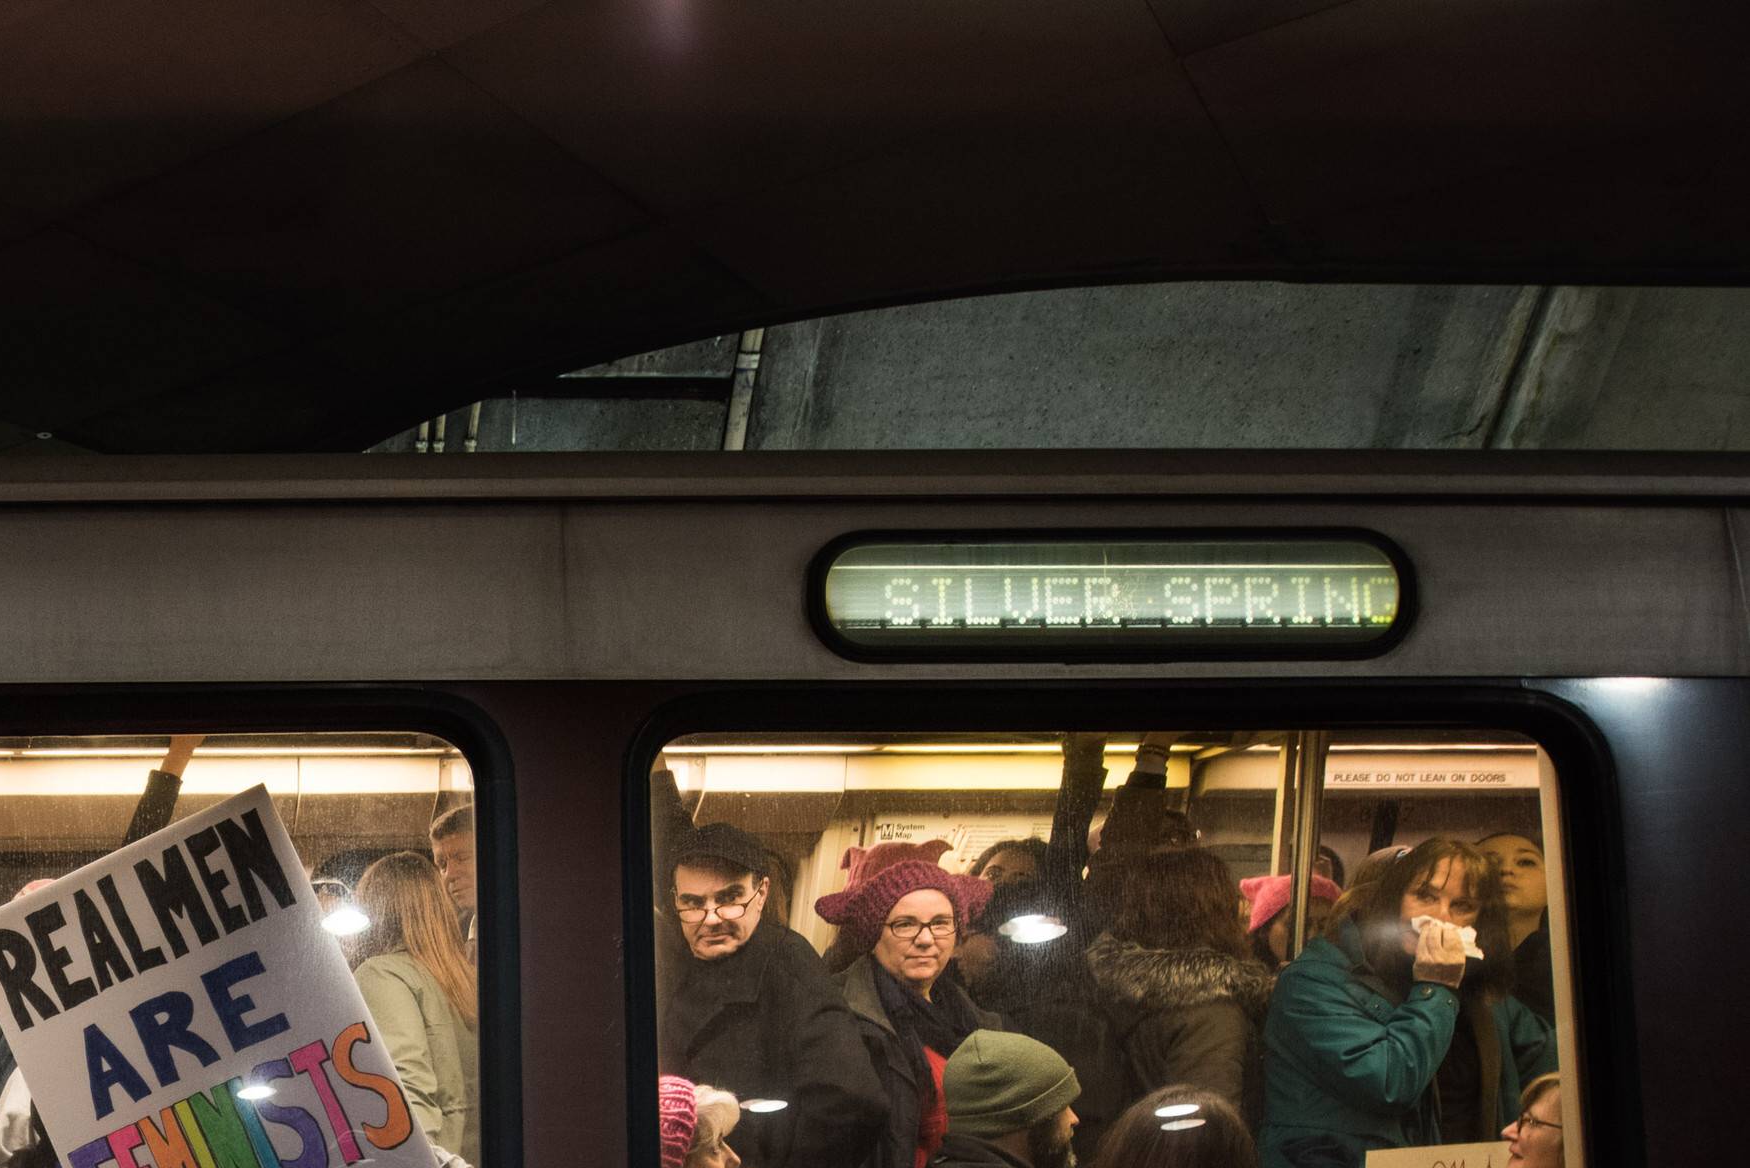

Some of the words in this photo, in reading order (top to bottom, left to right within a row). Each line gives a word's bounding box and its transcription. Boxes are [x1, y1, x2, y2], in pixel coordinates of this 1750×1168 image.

[885, 576, 1120, 625] SILVER
[1164, 575, 1397, 625] SPRING
[1333, 773, 1371, 782] PLEASE
[1376, 773, 1391, 782] DO
[1395, 773, 1416, 782] NOT
[1420, 773, 1446, 782] LEAN
[1451, 773, 1466, 782] ON
[1470, 773, 1507, 782] DOORS
[896, 823, 925, 831] System
[895, 832, 912, 840] Map
[82, 950, 291, 1122] ARE
